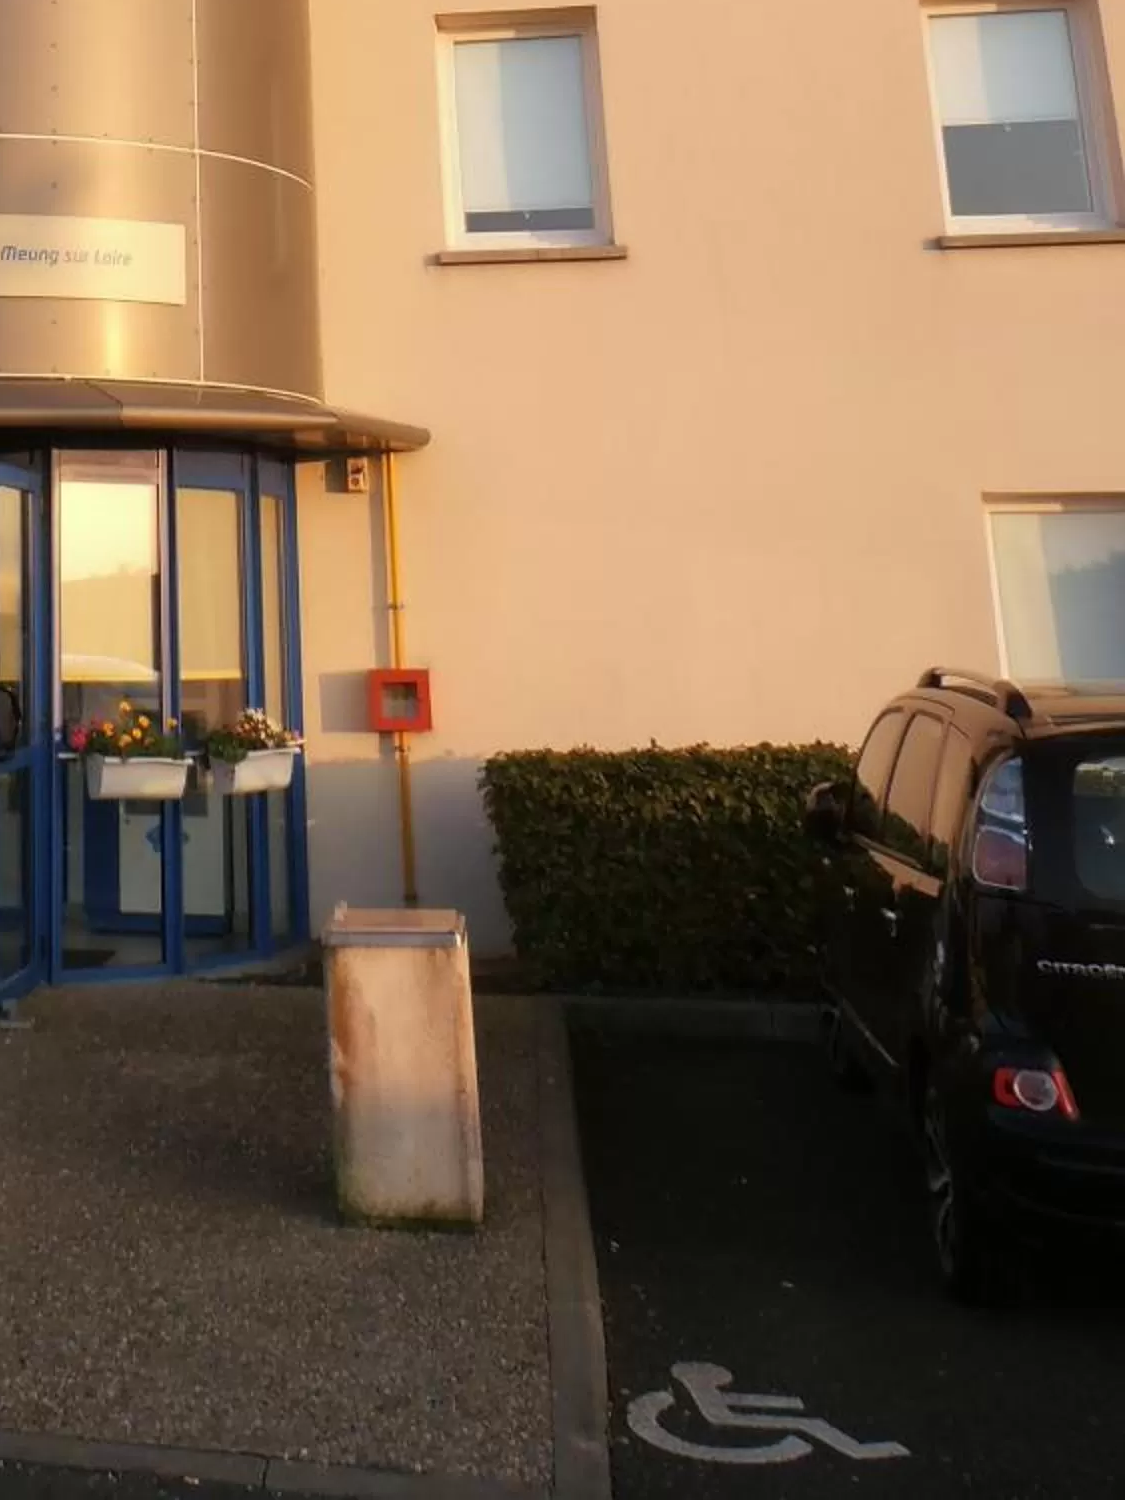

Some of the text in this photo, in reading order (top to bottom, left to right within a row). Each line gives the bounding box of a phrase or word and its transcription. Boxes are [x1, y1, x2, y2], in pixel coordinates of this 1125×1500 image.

[0, 244, 133, 267] Meung sur Loire
